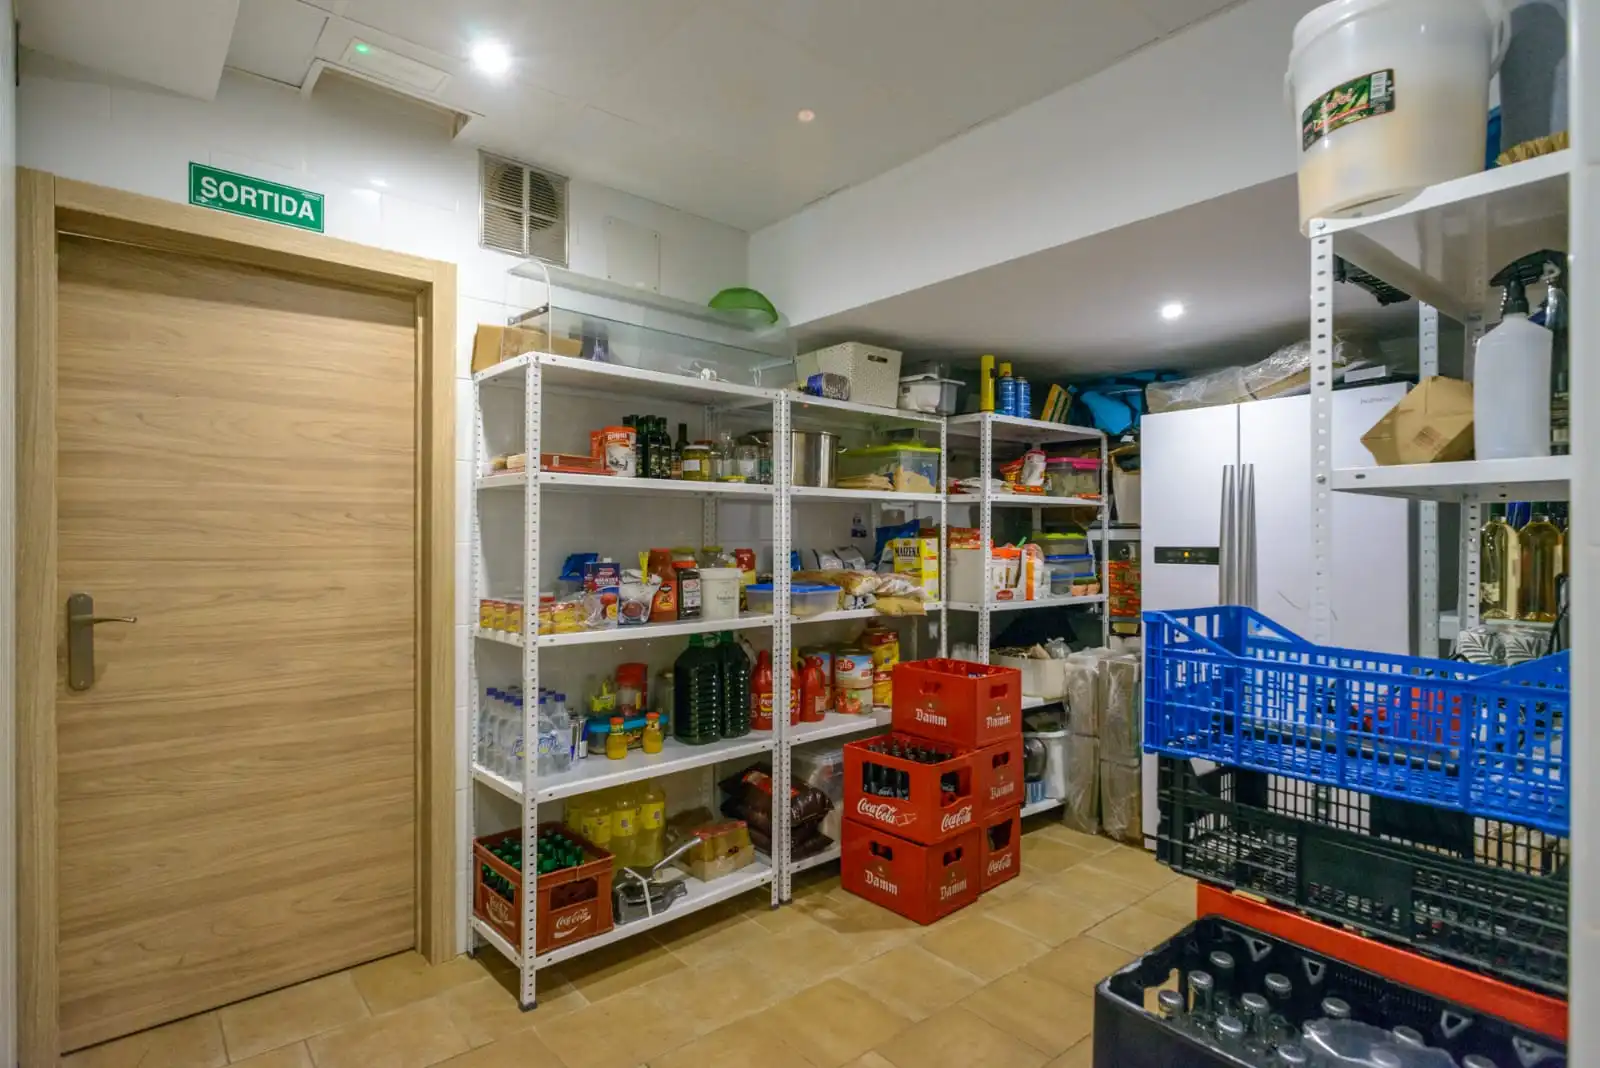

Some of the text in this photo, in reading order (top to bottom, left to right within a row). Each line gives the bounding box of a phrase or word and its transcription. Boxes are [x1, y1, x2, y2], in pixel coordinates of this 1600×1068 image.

[200, 176, 315, 221] SORTIDA
[915, 707, 948, 727] Damm
[985, 714, 1011, 729] Damm
[989, 782, 1015, 800] Damm
[864, 869, 899, 896] Damm
[939, 878, 968, 900] Damm
